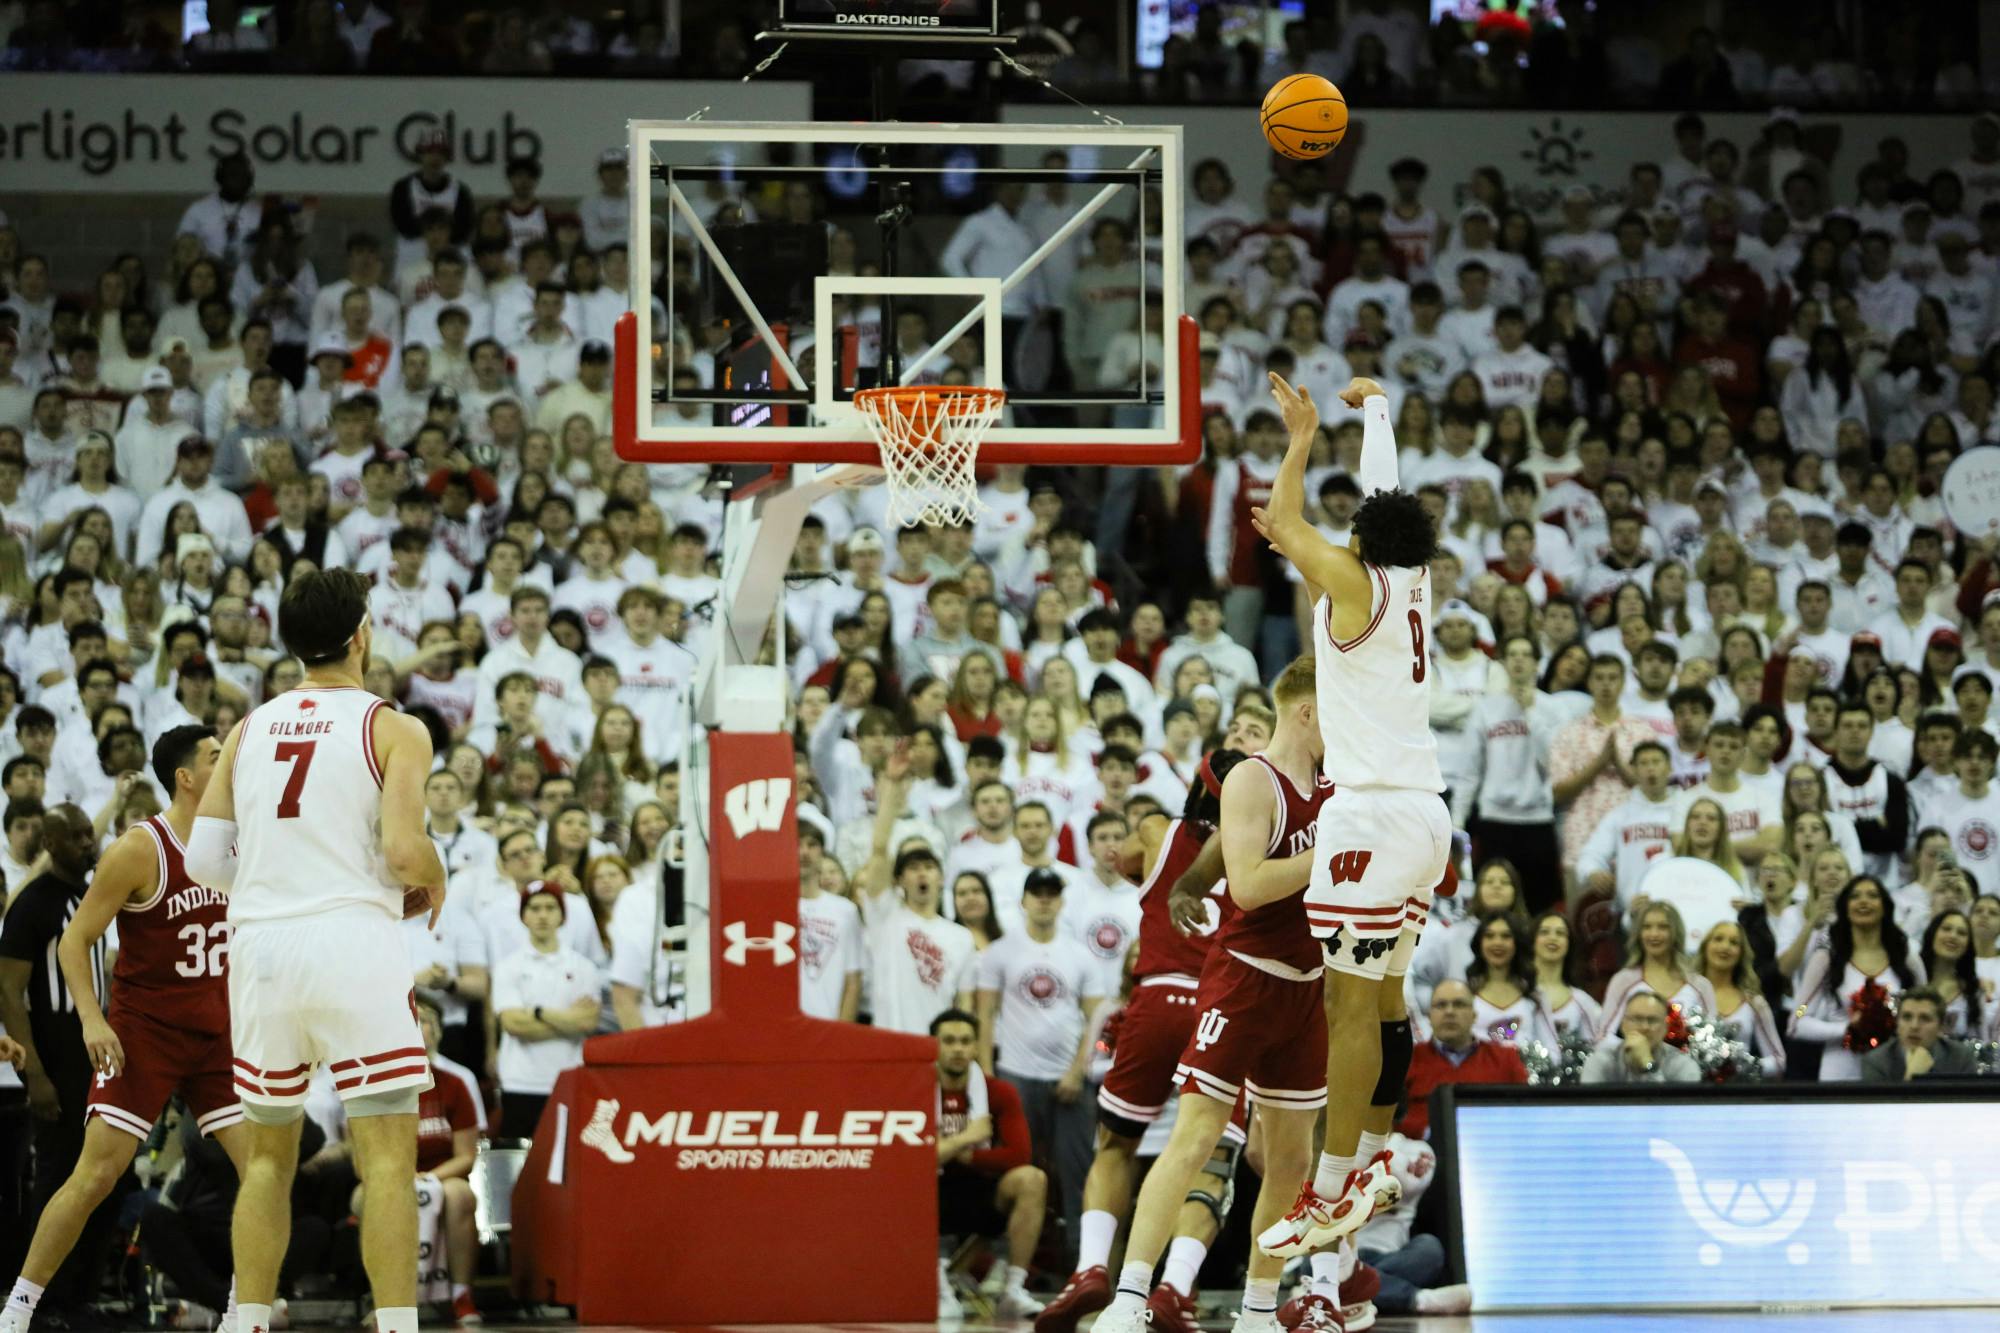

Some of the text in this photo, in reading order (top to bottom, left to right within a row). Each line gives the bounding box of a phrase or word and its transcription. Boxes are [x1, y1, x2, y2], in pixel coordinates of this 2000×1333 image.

[836, 14, 941, 26] DAKTRONICS
[0, 107, 543, 175] rlight Solar Club
[1407, 609, 1426, 684] 9
[269, 721, 334, 736] GILMORE
[274, 740, 317, 819] 7
[724, 777, 792, 841] W
[1329, 850, 1373, 887] W
[175, 921, 230, 978] 32
[624, 1111, 927, 1146] MUELLER
[677, 1149, 874, 1169] SPORTS MEDICINE
